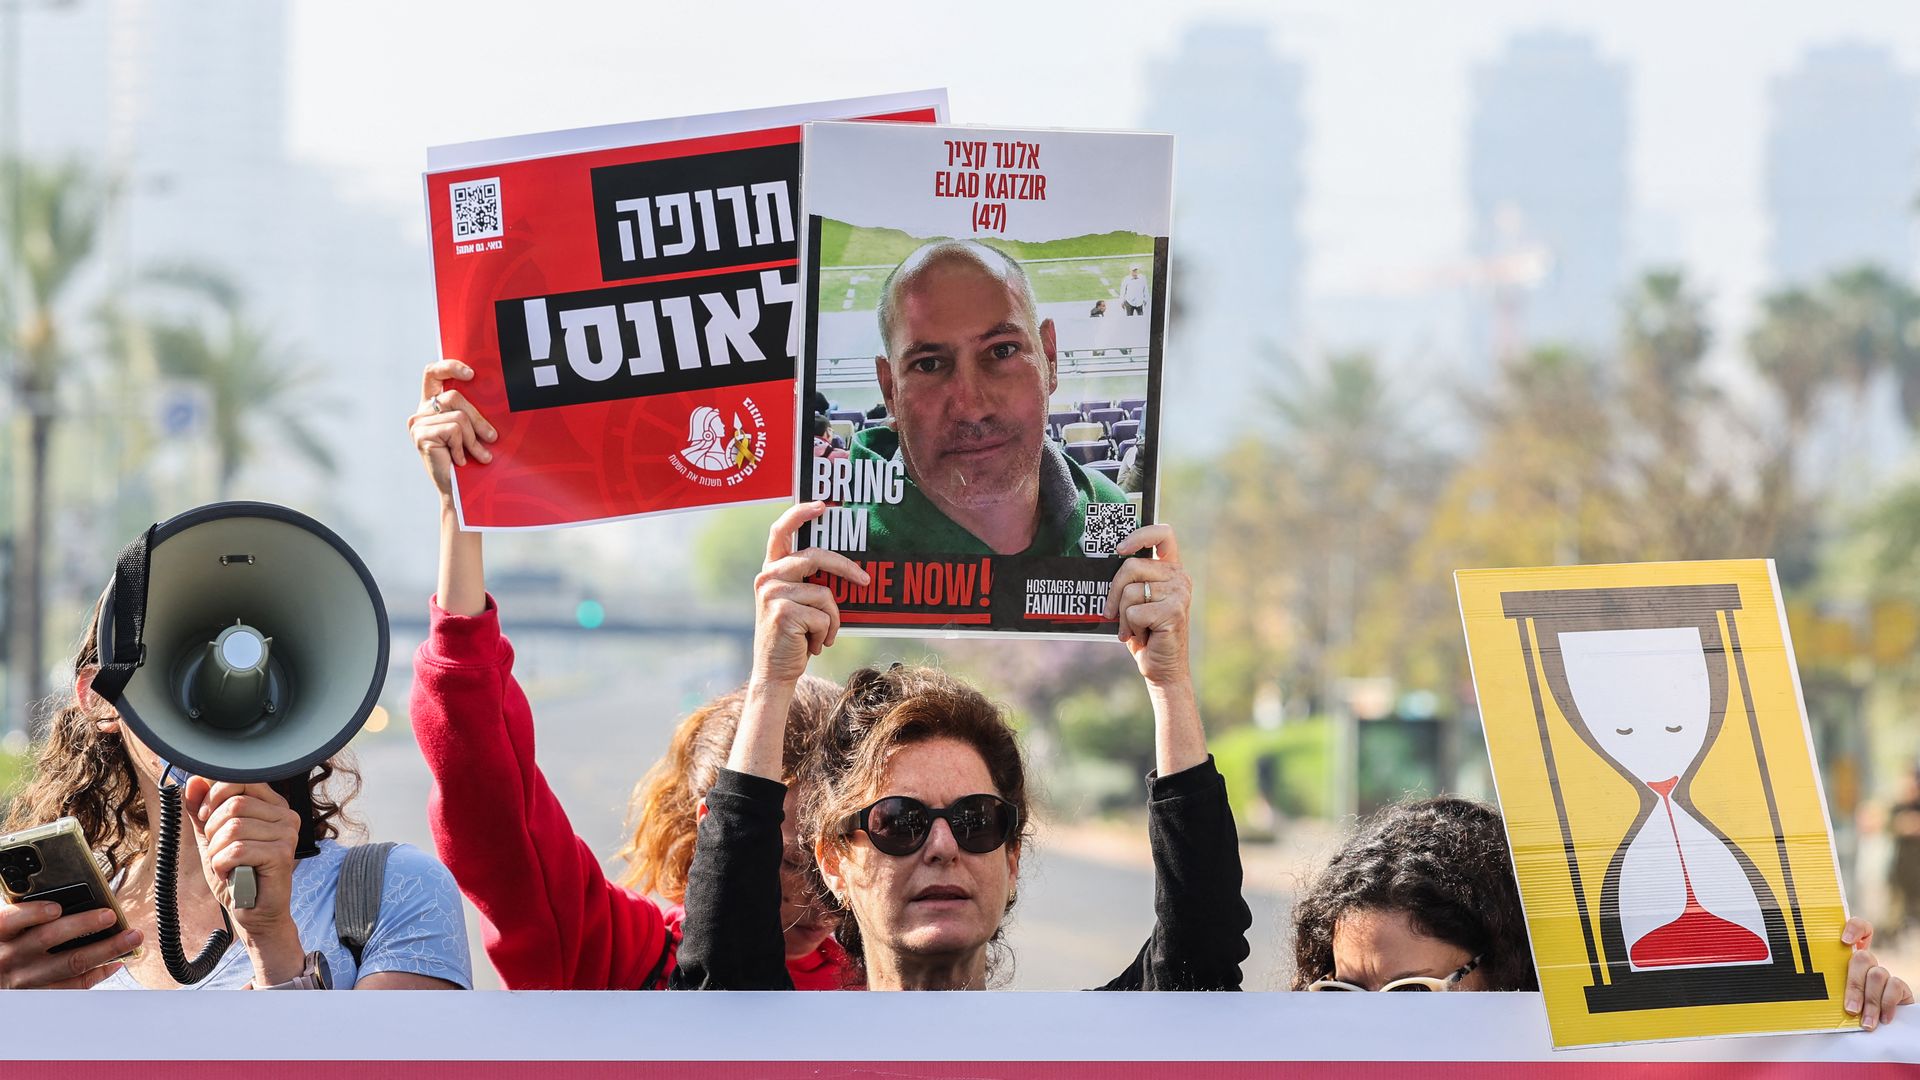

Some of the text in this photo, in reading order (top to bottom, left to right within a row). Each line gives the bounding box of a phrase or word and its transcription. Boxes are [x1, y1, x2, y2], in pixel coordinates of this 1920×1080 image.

[944, 140, 1040, 170] אלעד קציר
[935, 171, 1046, 200] ELAD KATZIR
[615, 180, 795, 262] תרופה
[972, 202, 1006, 233] (47)
[523, 269, 798, 387] לאונס!
[743, 397, 765, 428] בונות
[668, 454, 722, 487] משנות את השטח
[811, 457, 905, 504] BRING
[810, 507, 868, 551] HIM
[809, 558, 992, 607] OME NOW!
[1026, 578, 1074, 594] HOSTAGES
[1075, 580, 1095, 595] AND
[1025, 593, 1086, 615] FAMILIES
